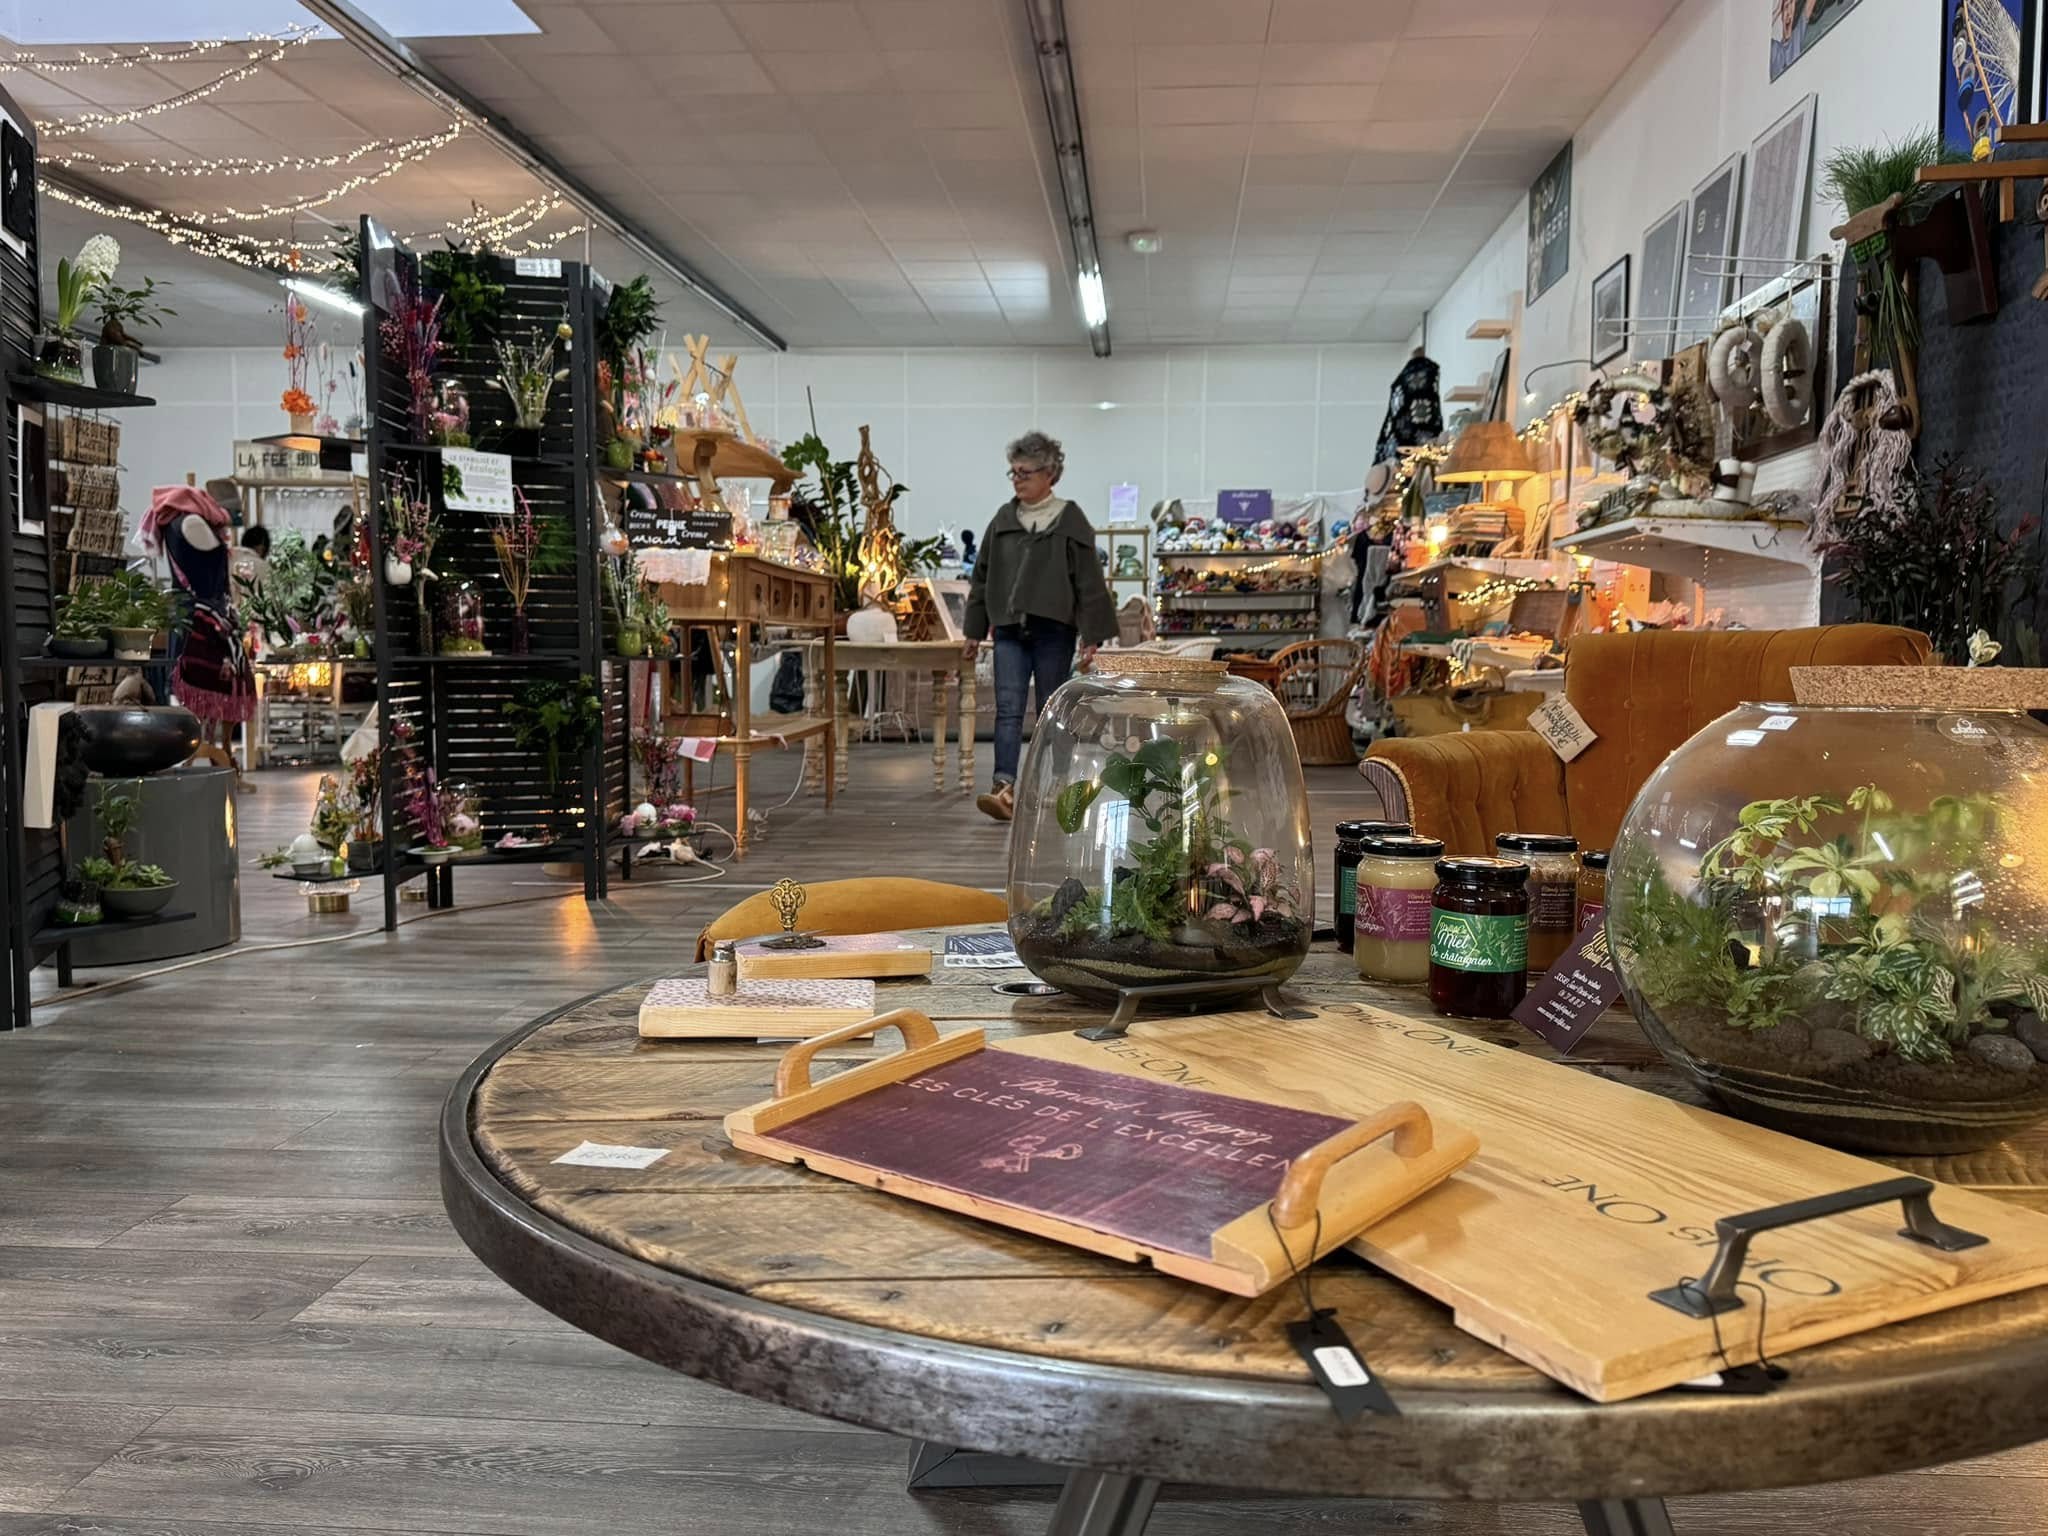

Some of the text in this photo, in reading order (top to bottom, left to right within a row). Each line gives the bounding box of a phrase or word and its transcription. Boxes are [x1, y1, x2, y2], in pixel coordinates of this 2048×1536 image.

[238, 452, 257, 469] LA
[1437, 930, 1470, 950] Miel
[1403, 1029, 1490, 1056] ONE
[1033, 1104, 1083, 1122] DE
[1540, 1174, 1668, 1225] ONE
